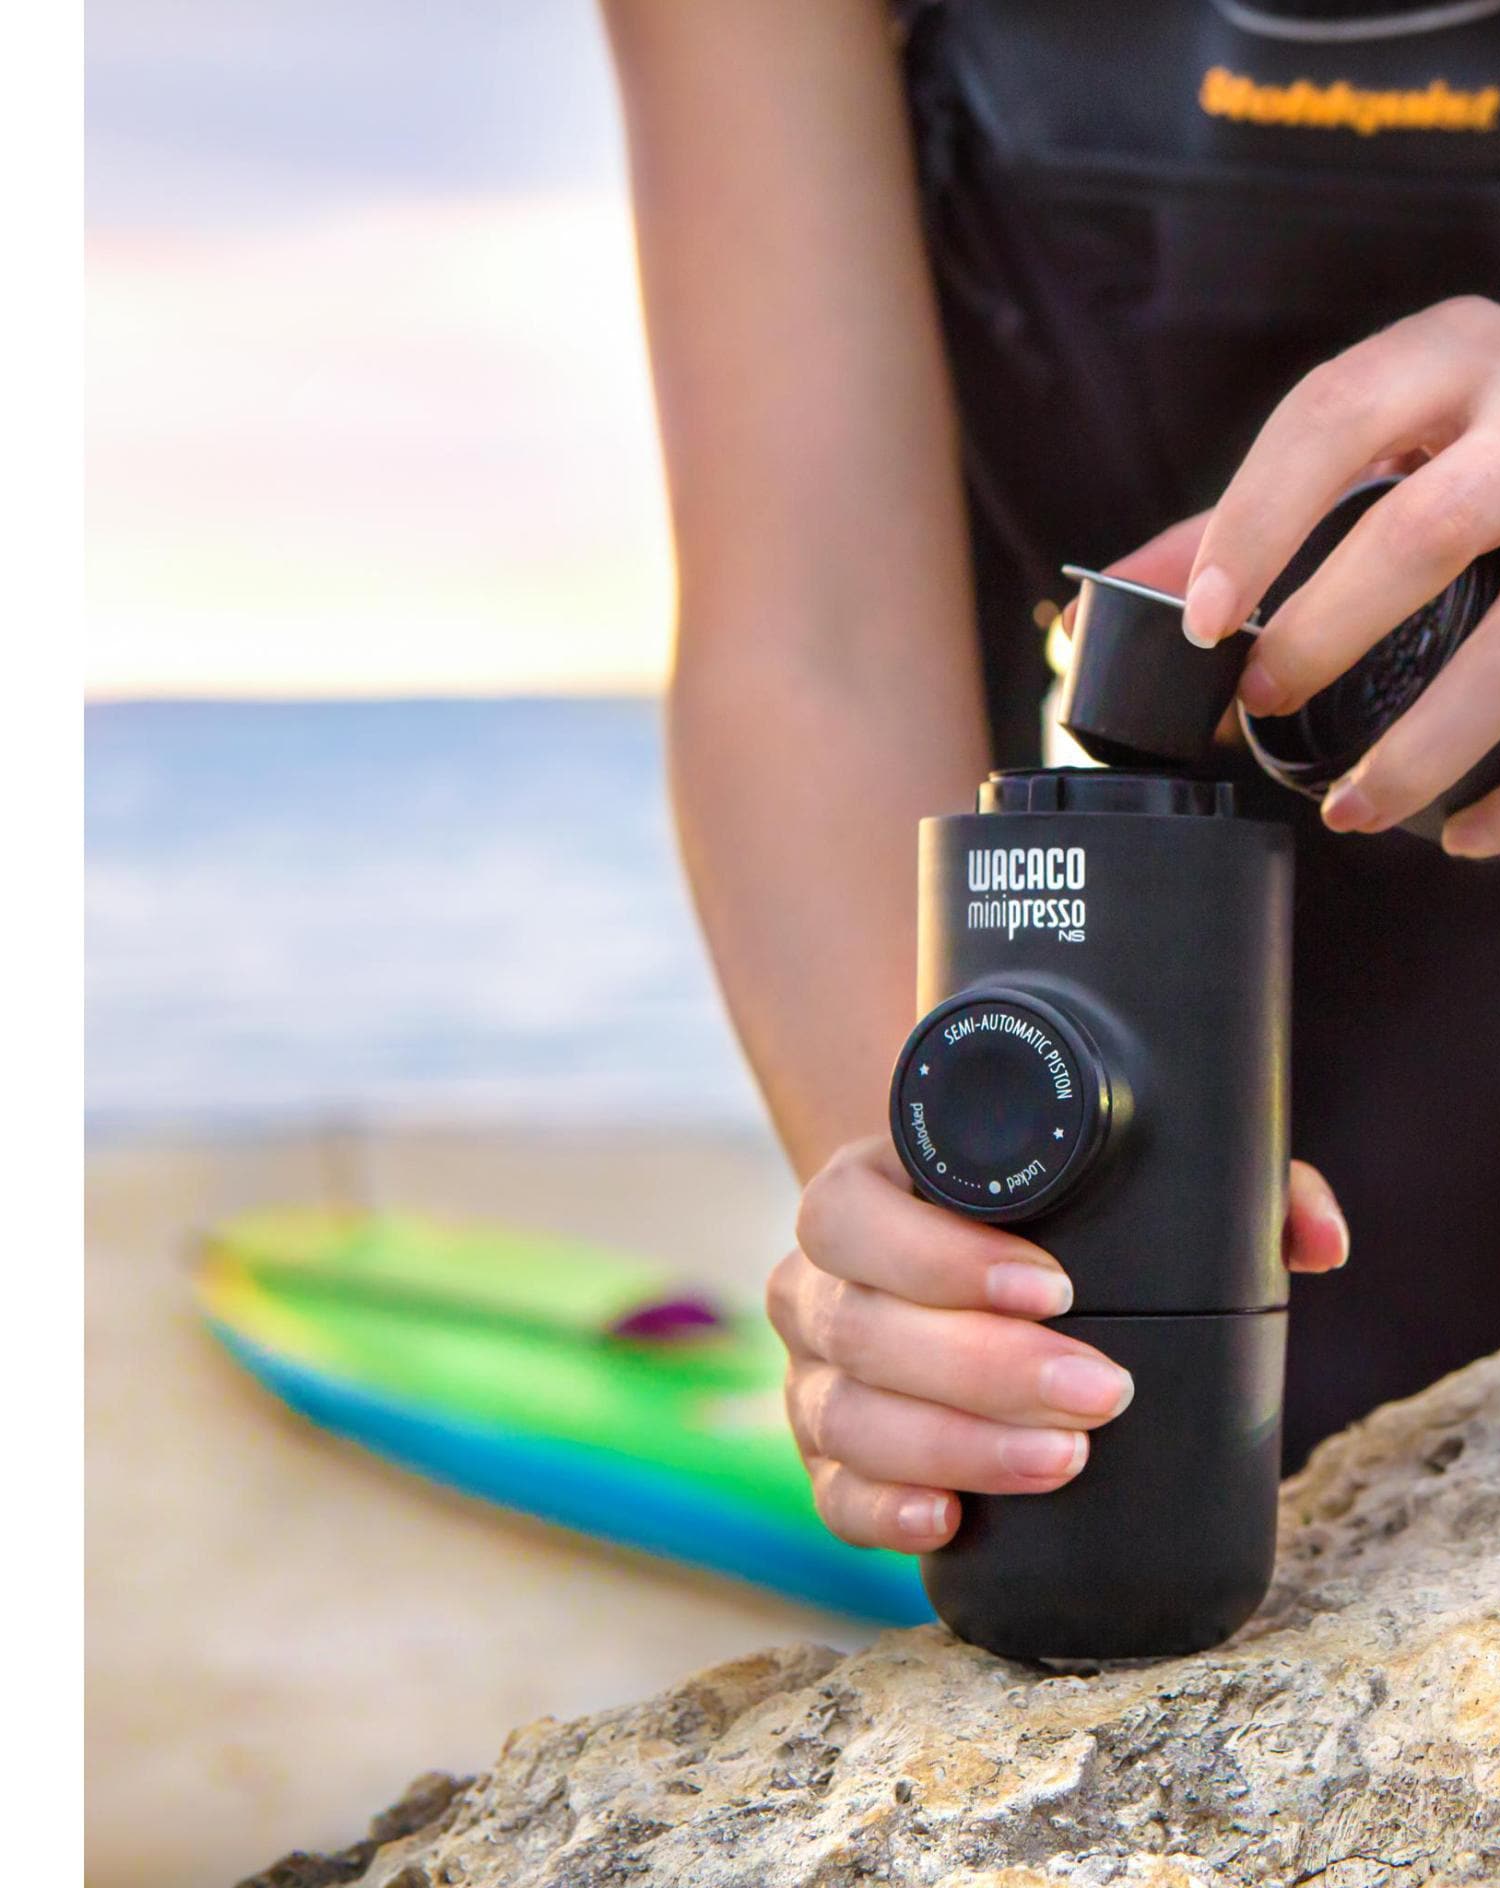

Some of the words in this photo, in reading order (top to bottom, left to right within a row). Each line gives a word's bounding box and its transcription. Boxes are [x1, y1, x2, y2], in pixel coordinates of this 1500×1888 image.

[968, 847, 1086, 892] WACACO
[968, 893, 1086, 941] minipresso
[1058, 930, 1086, 942] NS
[944, 1013, 1052, 1055] SEMI-AUTOMATIC
[1044, 1049, 1073, 1100] PISTON
[910, 1102, 937, 1162] Unlocked
[1006, 1158, 1047, 1194] Locked
